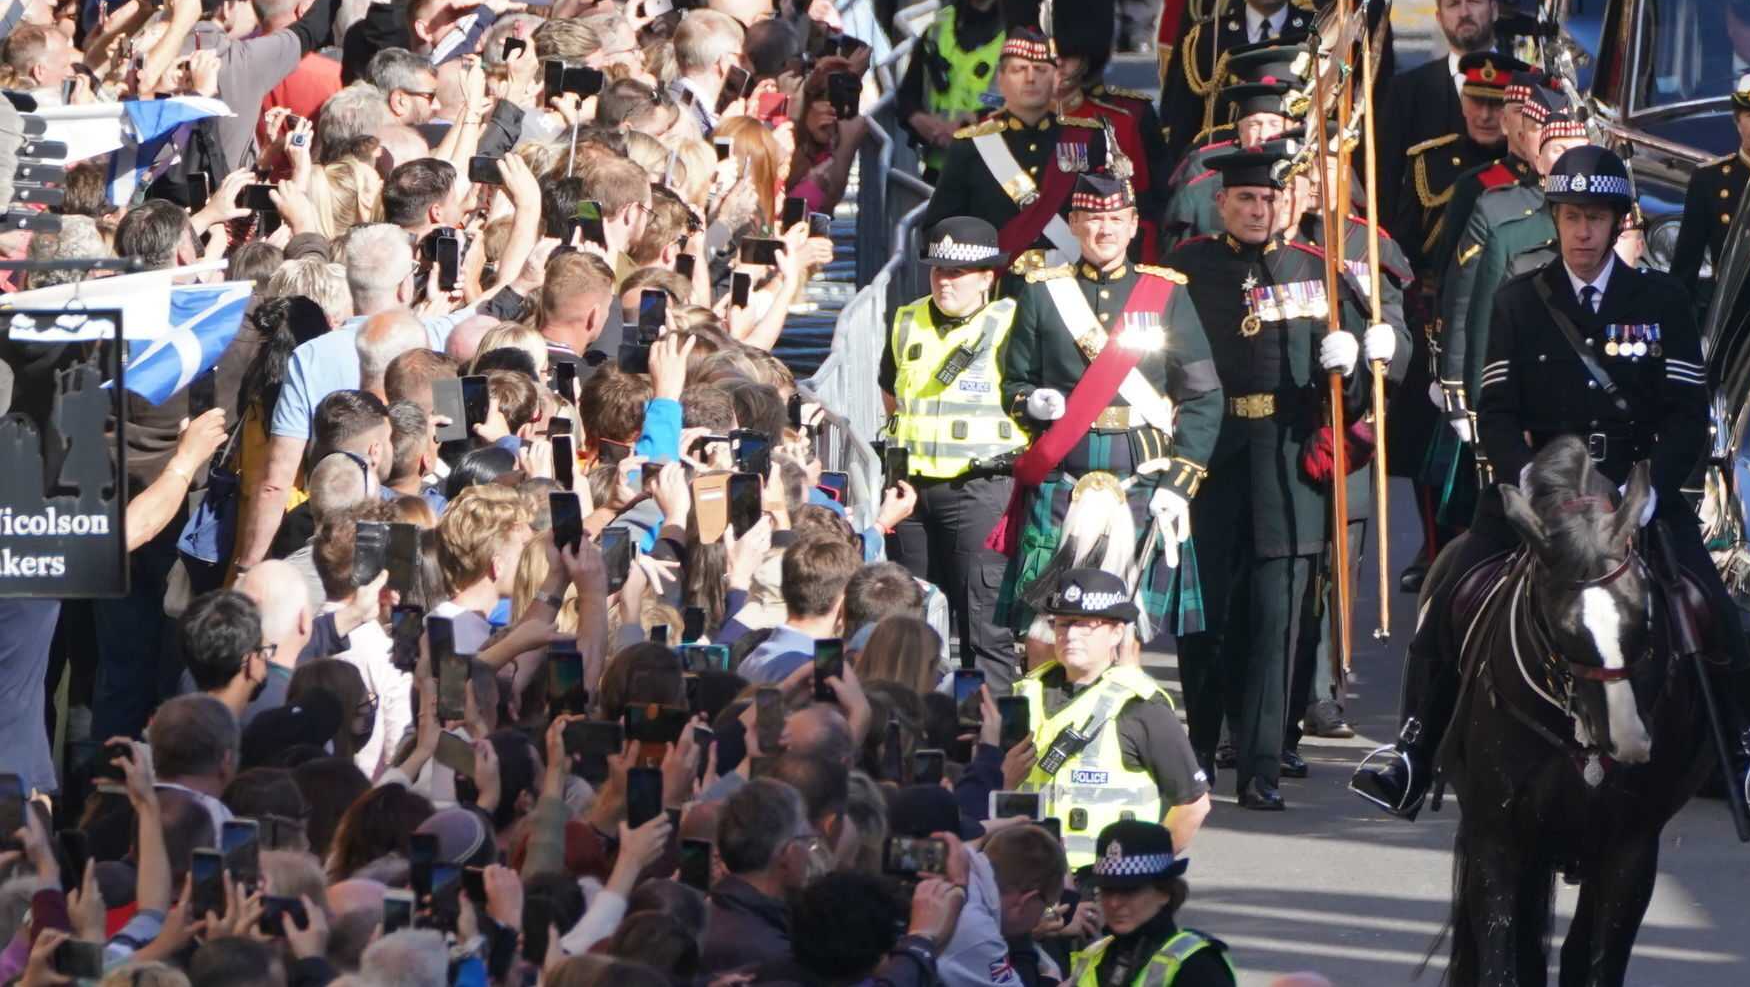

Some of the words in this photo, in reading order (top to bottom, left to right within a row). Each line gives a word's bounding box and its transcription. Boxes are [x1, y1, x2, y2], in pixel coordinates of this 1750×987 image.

[0, 506, 109, 535] icolson
[0, 548, 65, 577] kers
[1072, 771, 1106, 782] POLICE
